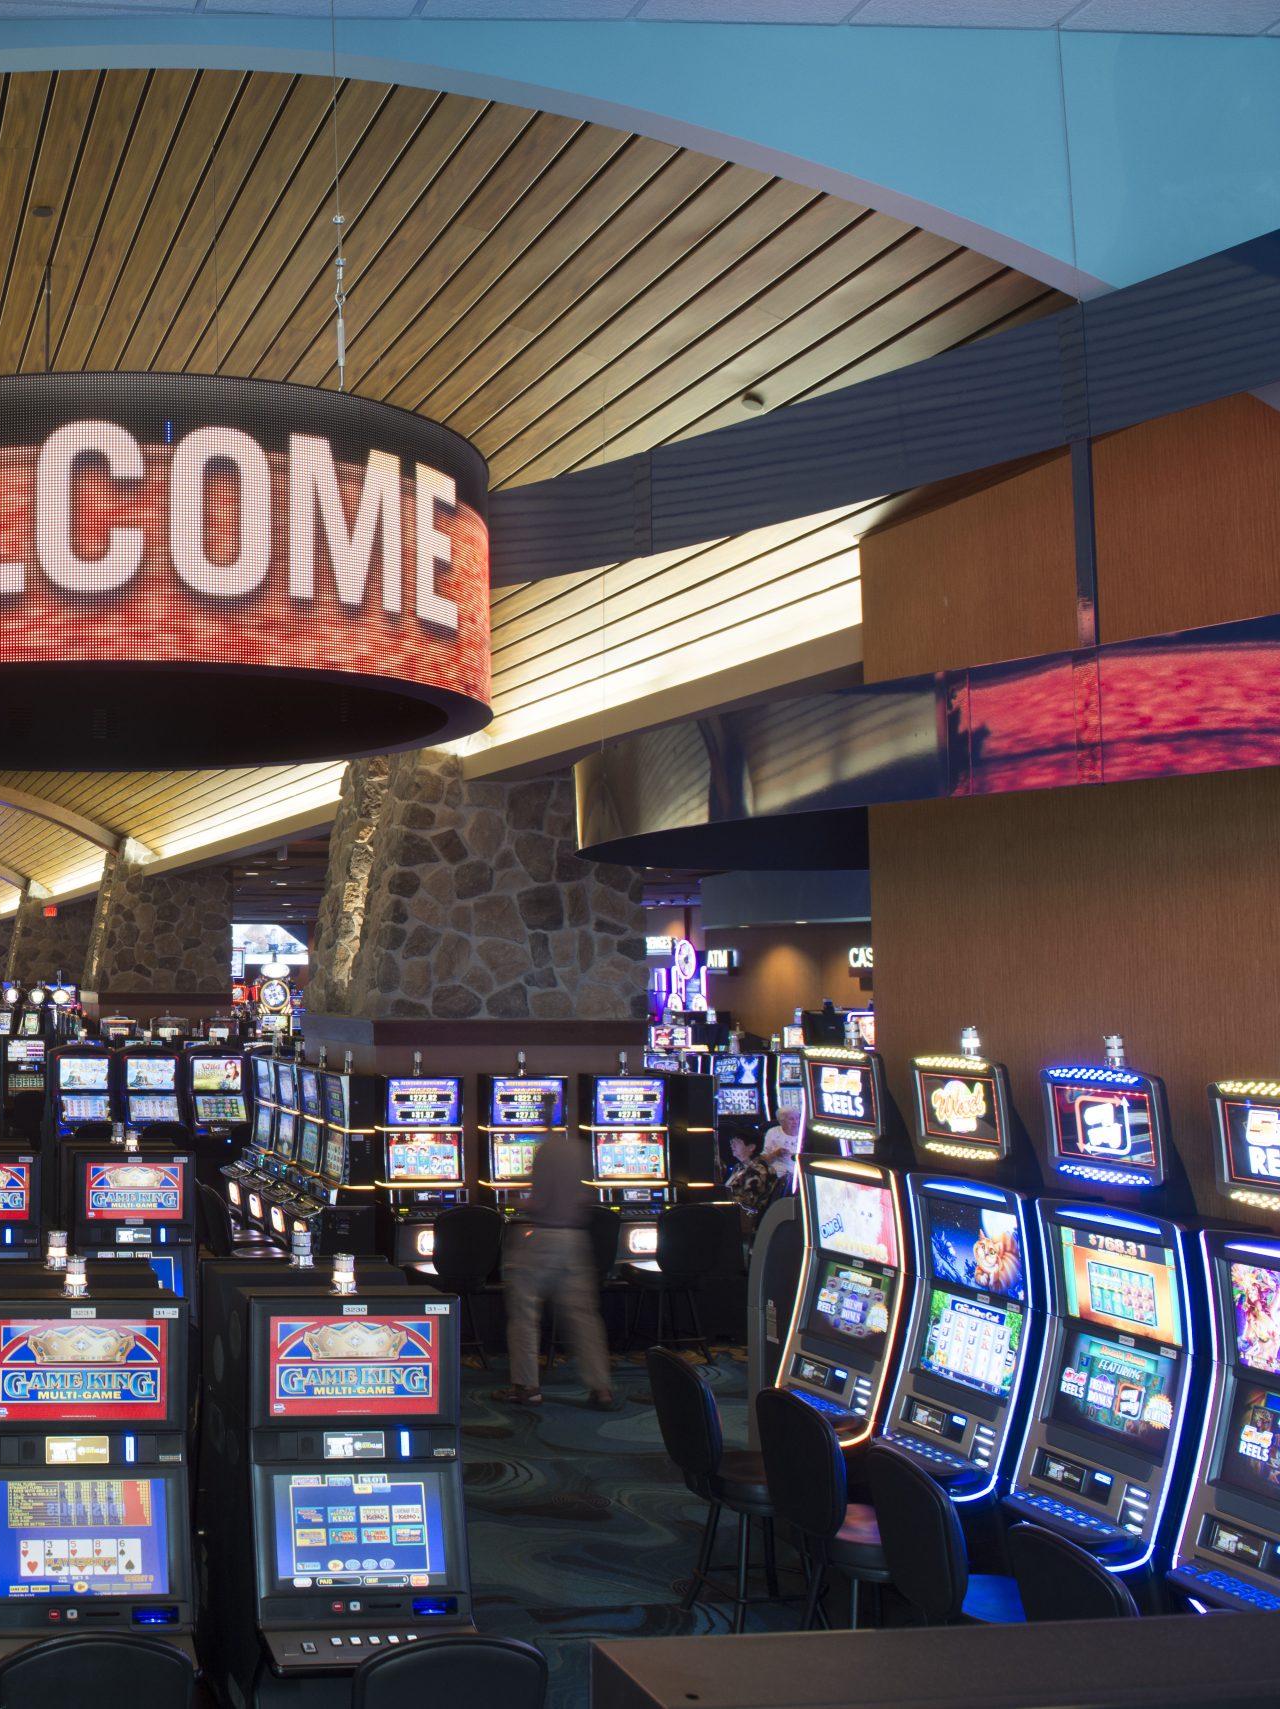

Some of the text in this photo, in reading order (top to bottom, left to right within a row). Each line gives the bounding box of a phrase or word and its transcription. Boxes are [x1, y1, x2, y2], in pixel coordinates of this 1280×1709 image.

[707, 950, 728, 967] ATM
[716, 1065, 737, 1074] STAG
[822, 1093, 865, 1117] REELS
[92, 1192, 177, 1208] GAME KING
[821, 1213, 844, 1238] OMG!
[1088, 1233, 1146, 1259] $768.31
[840, 1280, 870, 1296] FEATURING
[985, 1312, 1000, 1324] Cat
[1081, 1356, 1091, 1366] J
[1098, 1360, 1144, 1380] FEATURING
[3, 1371, 157, 1399] GAME KING
[280, 1367, 428, 1395] GAME KING
[1061, 1381, 1085, 1398] REELS
[37, 1391, 122, 1400] MULTI-GAME
[313, 1386, 395, 1395] MULTI-GAME
[1239, 1440, 1270, 1462] REELS
[362, 1476, 383, 1484] SLOT
